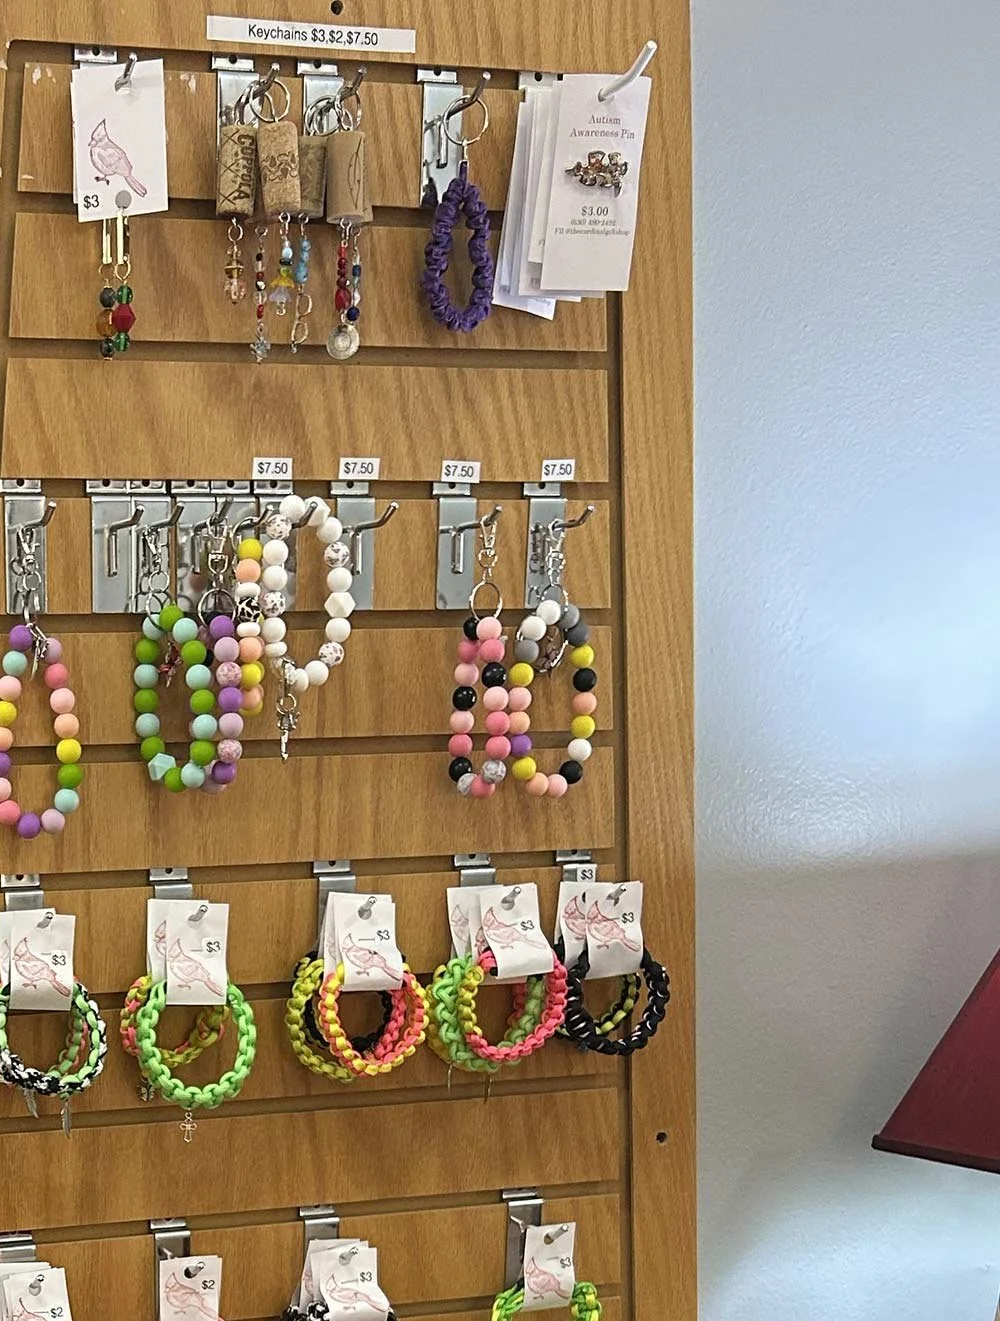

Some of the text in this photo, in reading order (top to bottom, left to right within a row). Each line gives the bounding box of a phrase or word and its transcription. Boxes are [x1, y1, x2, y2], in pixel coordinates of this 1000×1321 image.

[248, 24, 379, 47] Keychains $3,$2,$7.50
[588, 114, 621, 126] Autism
[570, 128, 635, 140] Awareness Pin
[83, 194, 100, 210] $3
[580, 206, 609, 217] $3.00
[257, 462, 289, 475] $7.50
[343, 462, 374, 475] $7.50
[444, 464, 474, 478] $7.50
[543, 463, 573, 477] $7.50
[580, 869, 594, 881] $3
[621, 912, 635, 924] $3
[520, 919, 535, 932] $3
[376, 929, 391, 942] $3
[206, 941, 221, 953] $3
[51, 954, 67, 967] $3
[560, 1256, 572, 1269] $3
[359, 1271, 373, 1283] $3
[201, 1279, 215, 1291] $2
[50, 1306, 64, 1319] $2
